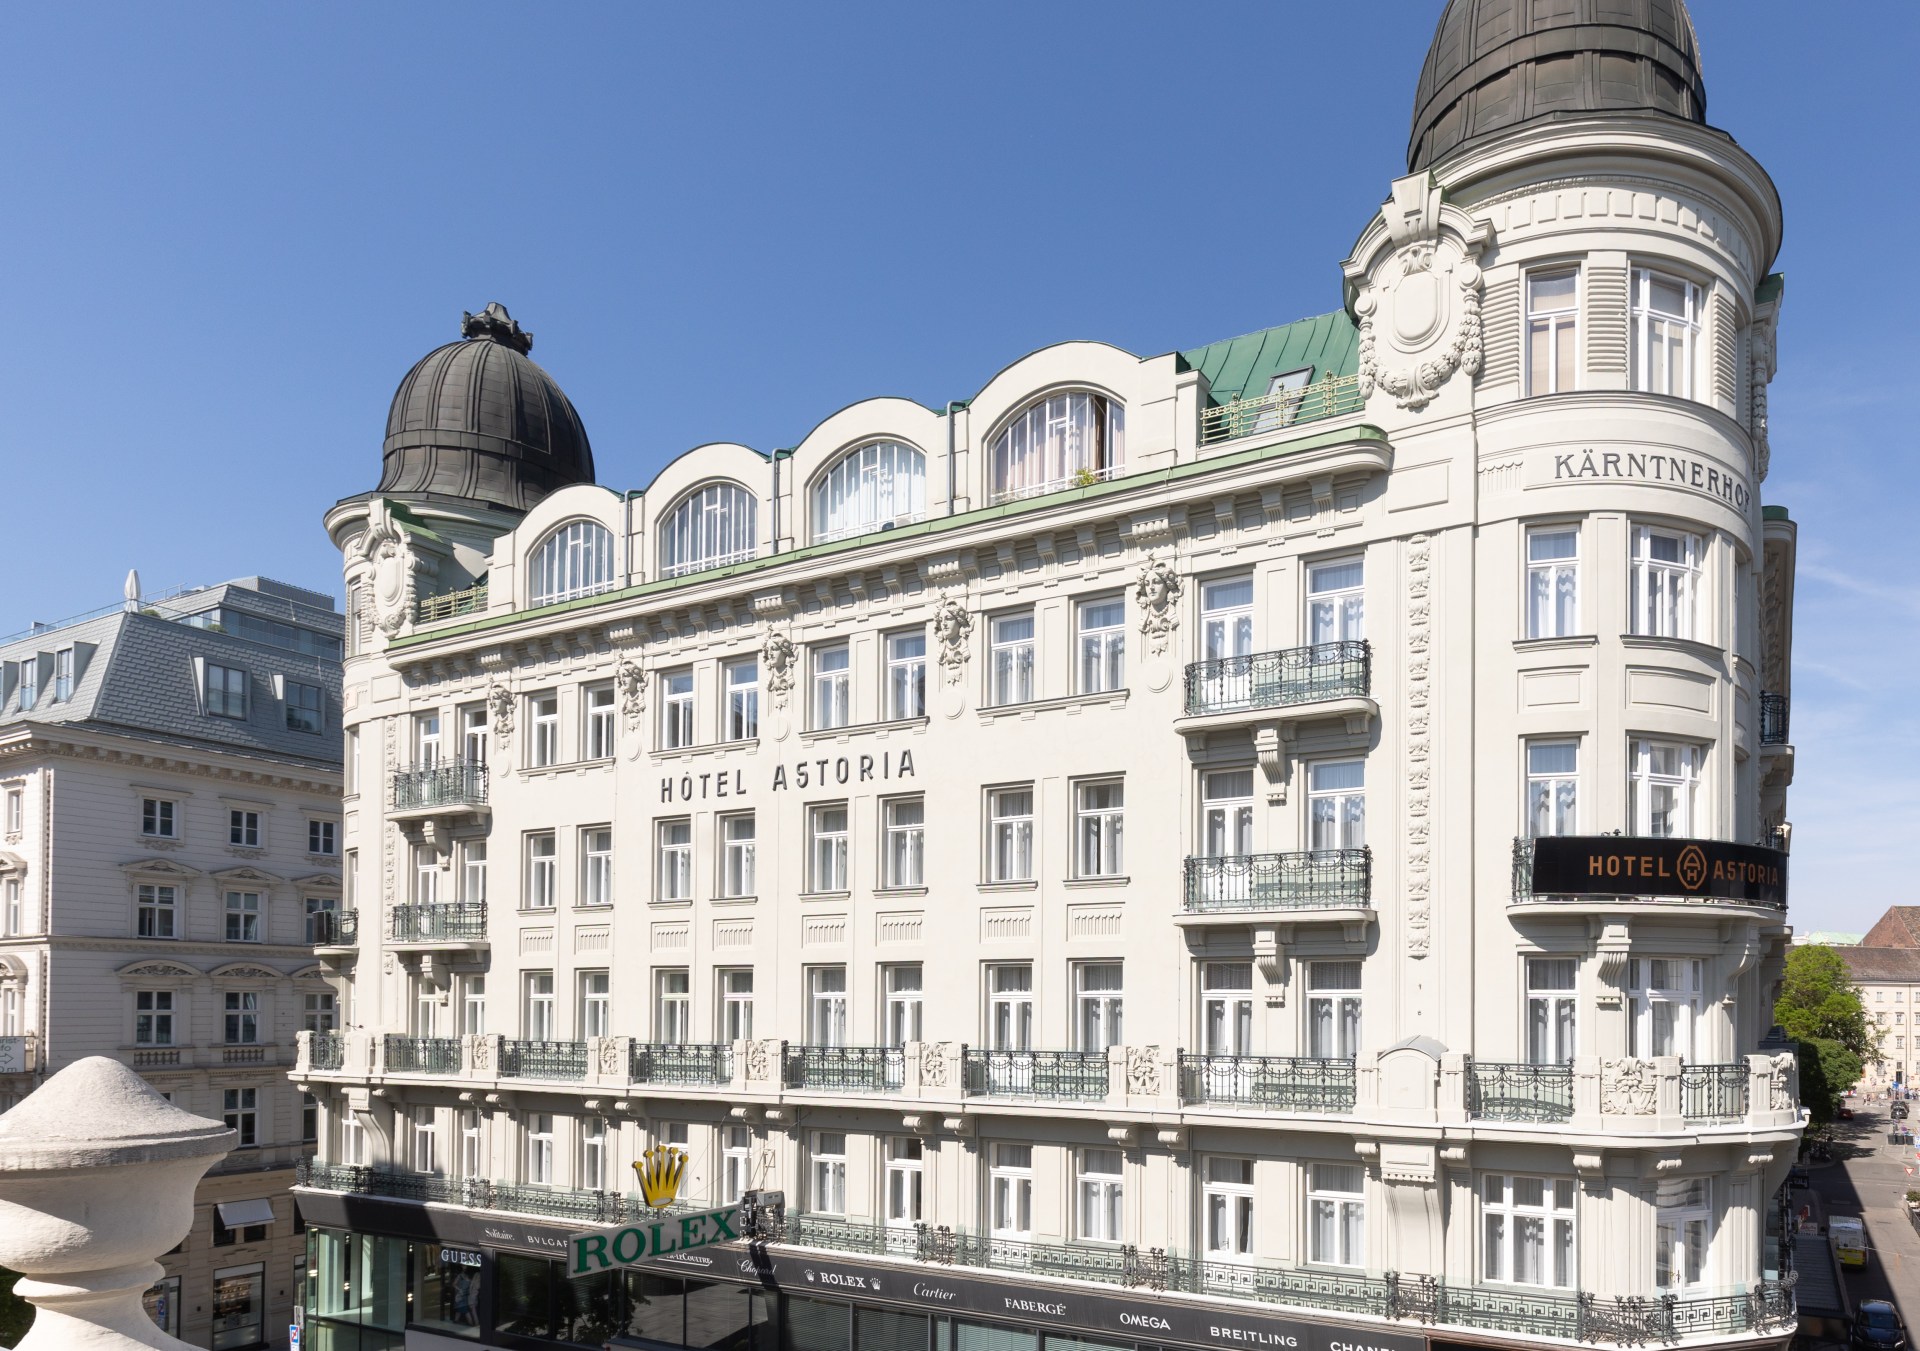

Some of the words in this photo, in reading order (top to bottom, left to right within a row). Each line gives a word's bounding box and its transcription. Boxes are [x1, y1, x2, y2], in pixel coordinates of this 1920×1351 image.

[772, 748, 915, 792] ASTORIA
[1588, 855, 1671, 878] HOTEL
[1713, 859, 1779, 887] ASTORIA
[573, 1208, 739, 1274] ROLEX
[441, 1249, 482, 1267] GUESS
[737, 1258, 777, 1277] Chopard
[819, 1272, 867, 1289] ROLEX
[913, 1281, 957, 1300] Cartier
[1004, 1298, 1066, 1315] FABERGÉ
[1119, 1312, 1172, 1331] OMEGA
[1209, 1326, 1298, 1347] BREITLING
